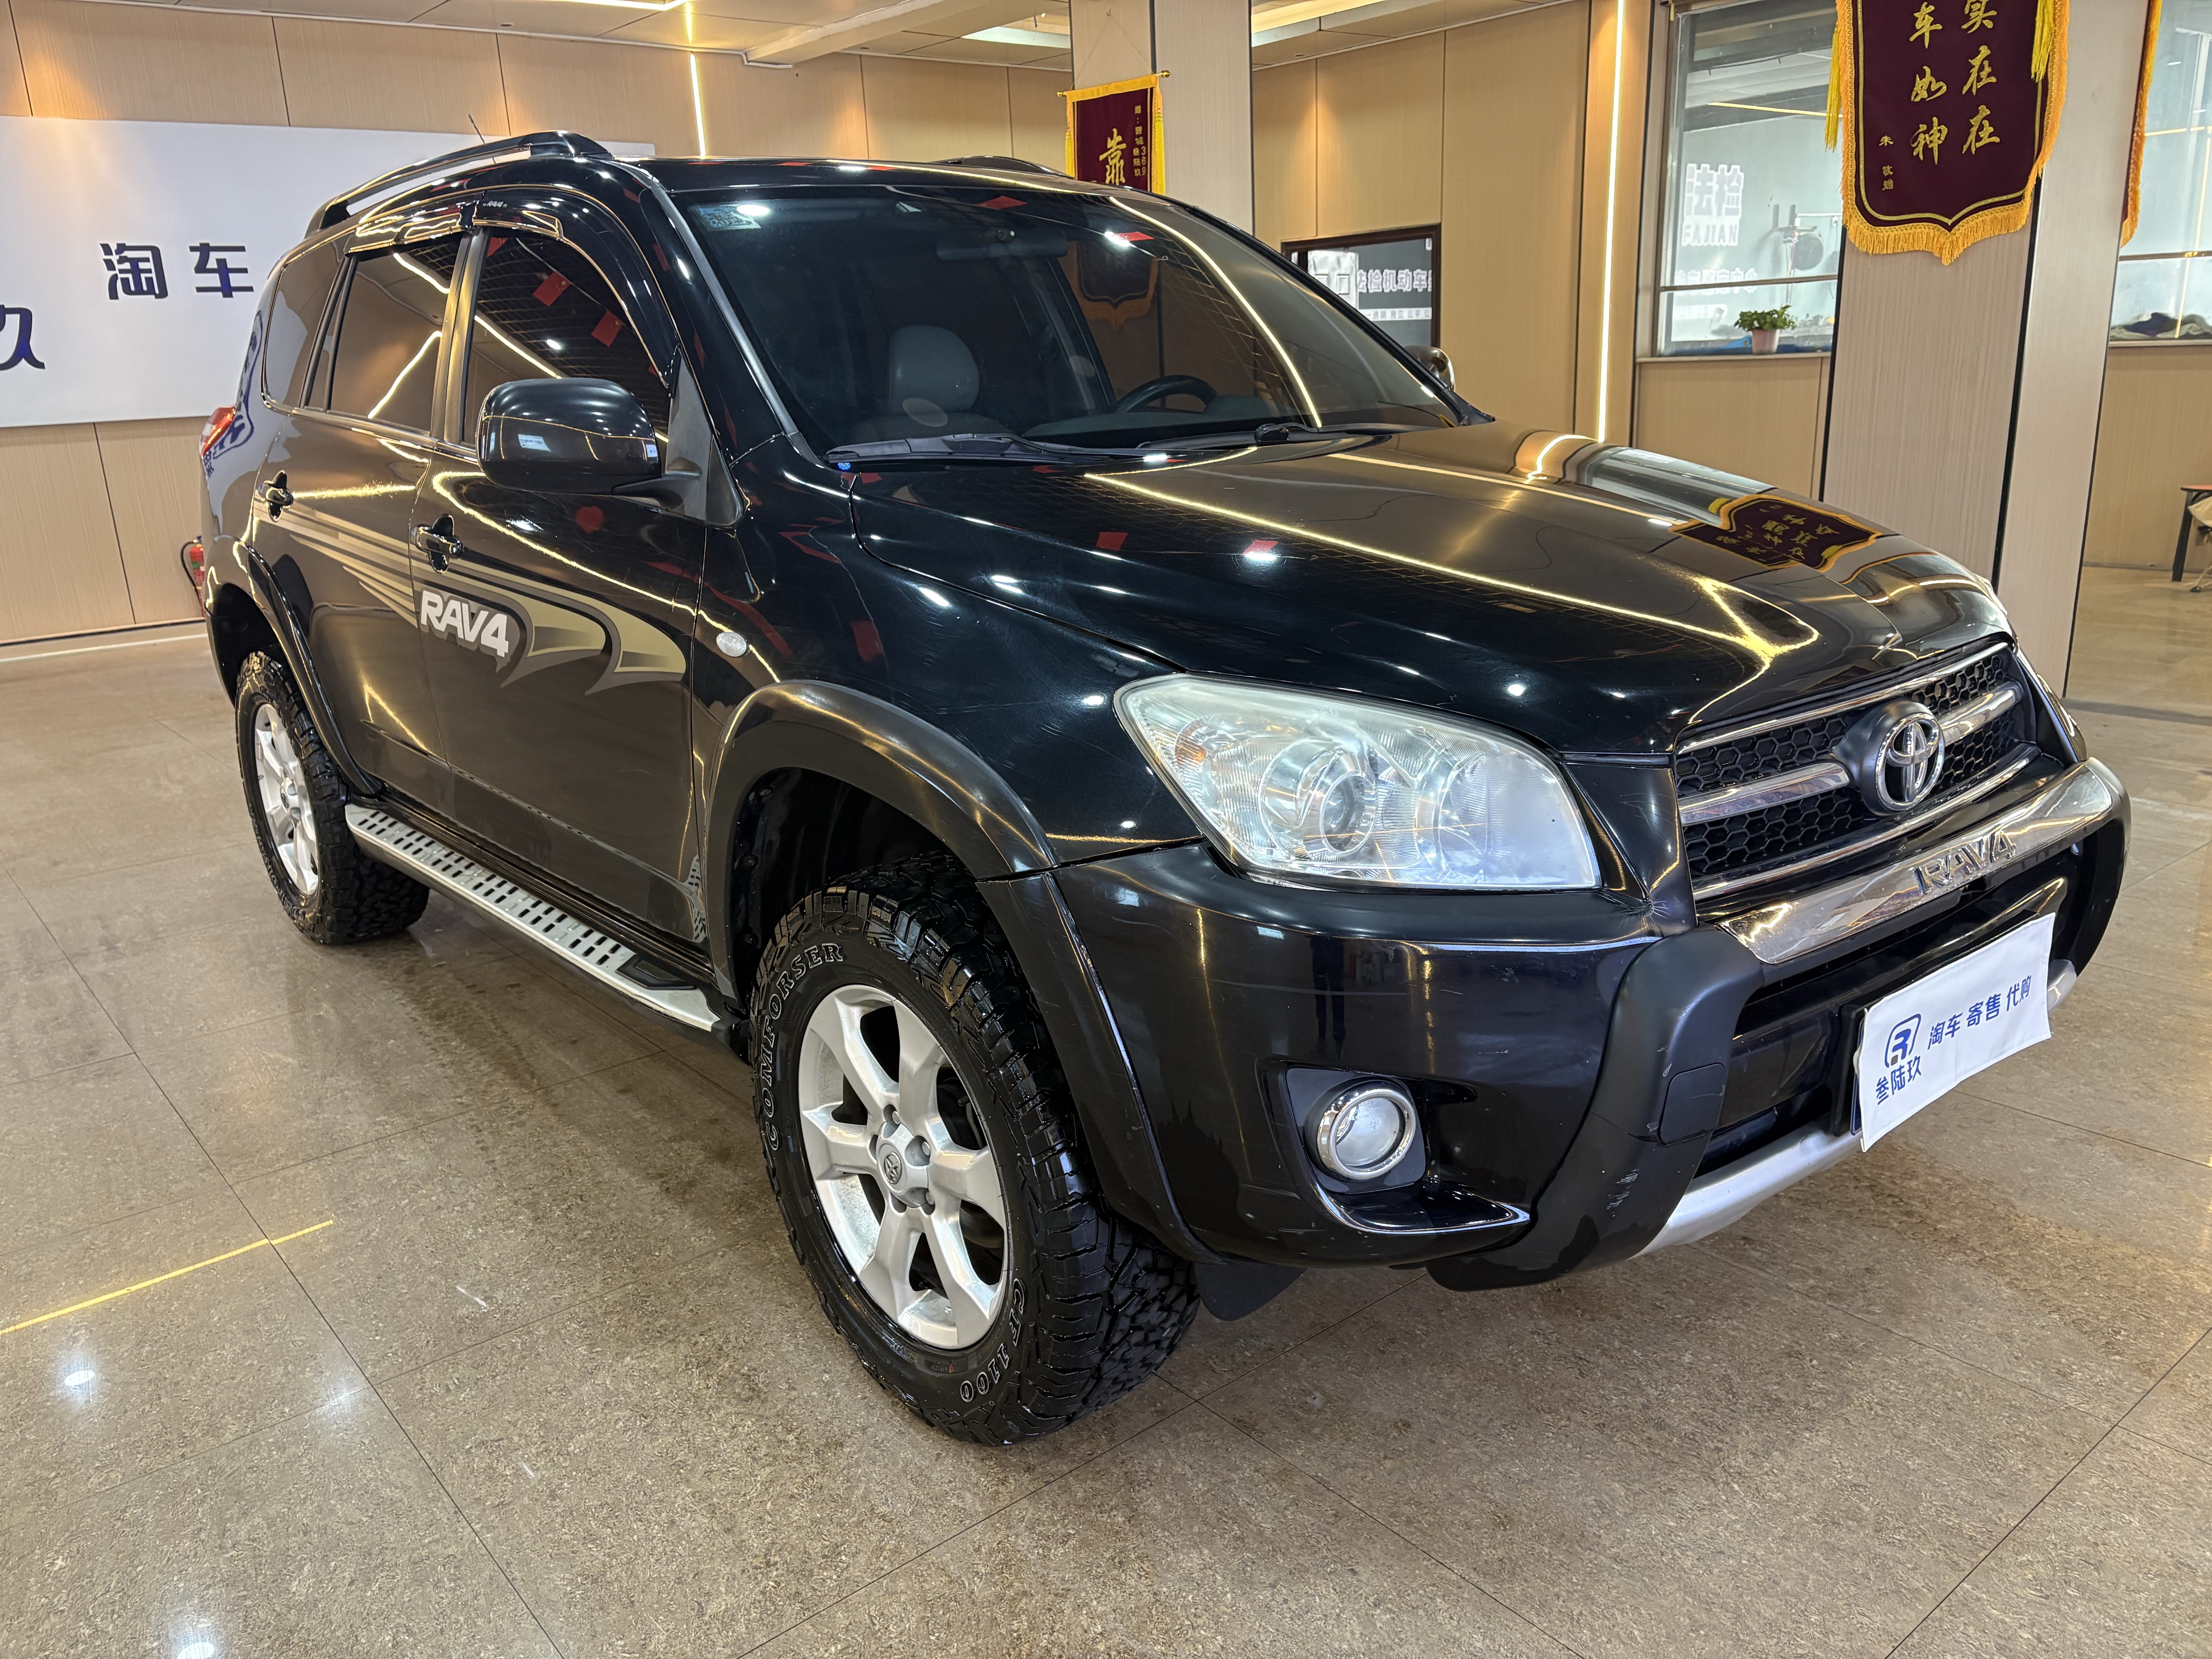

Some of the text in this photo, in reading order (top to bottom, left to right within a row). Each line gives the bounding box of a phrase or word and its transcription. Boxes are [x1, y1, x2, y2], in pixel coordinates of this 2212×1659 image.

[99, 242, 254, 300] 淘车
[421, 590, 509, 658] RAV4
[1909, 830, 2016, 896] RAV4
[760, 942, 845, 1151] COMFORSER
[1927, 975, 2032, 1050] 淘车 寄售 代购
[1876, 1055, 1922, 1106] 叁陆玖
[960, 1278, 1025, 1402] CF1100
